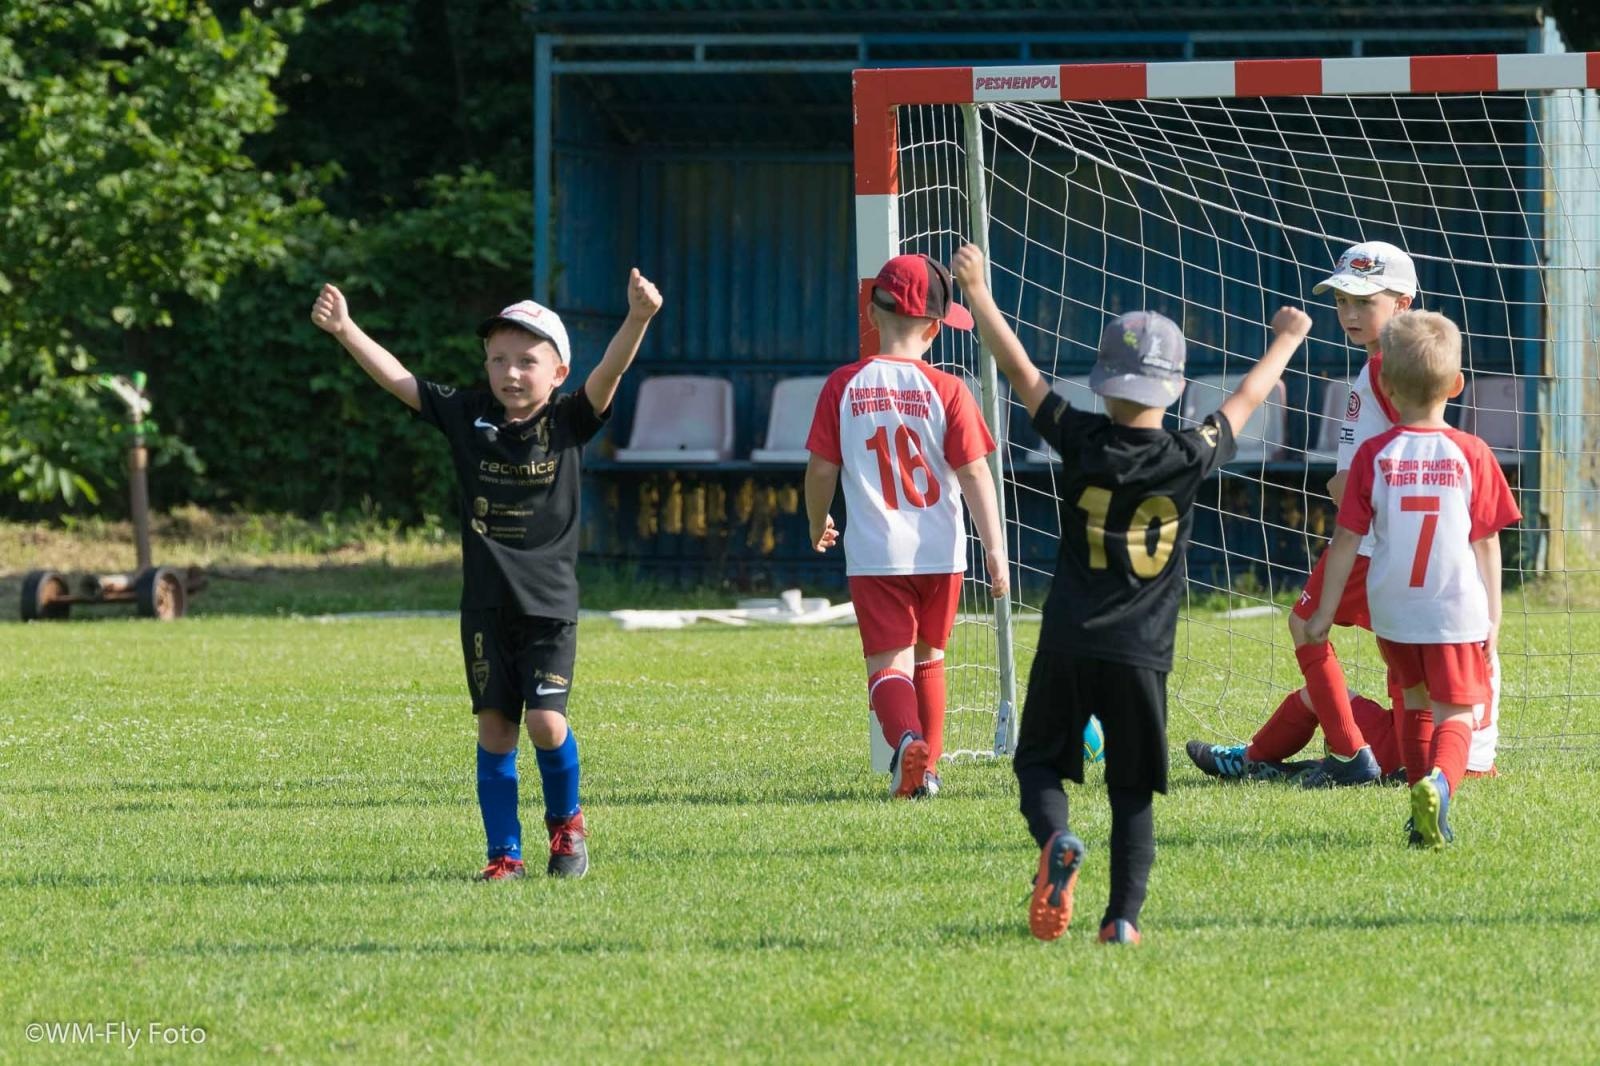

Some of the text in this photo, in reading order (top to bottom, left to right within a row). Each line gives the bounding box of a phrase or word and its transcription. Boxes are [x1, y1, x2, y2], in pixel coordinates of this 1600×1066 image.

[975, 76, 1058, 90] PESMENPOL
[865, 424, 940, 510] 16
[1077, 486, 1179, 578] 10
[1401, 496, 1440, 587] 7
